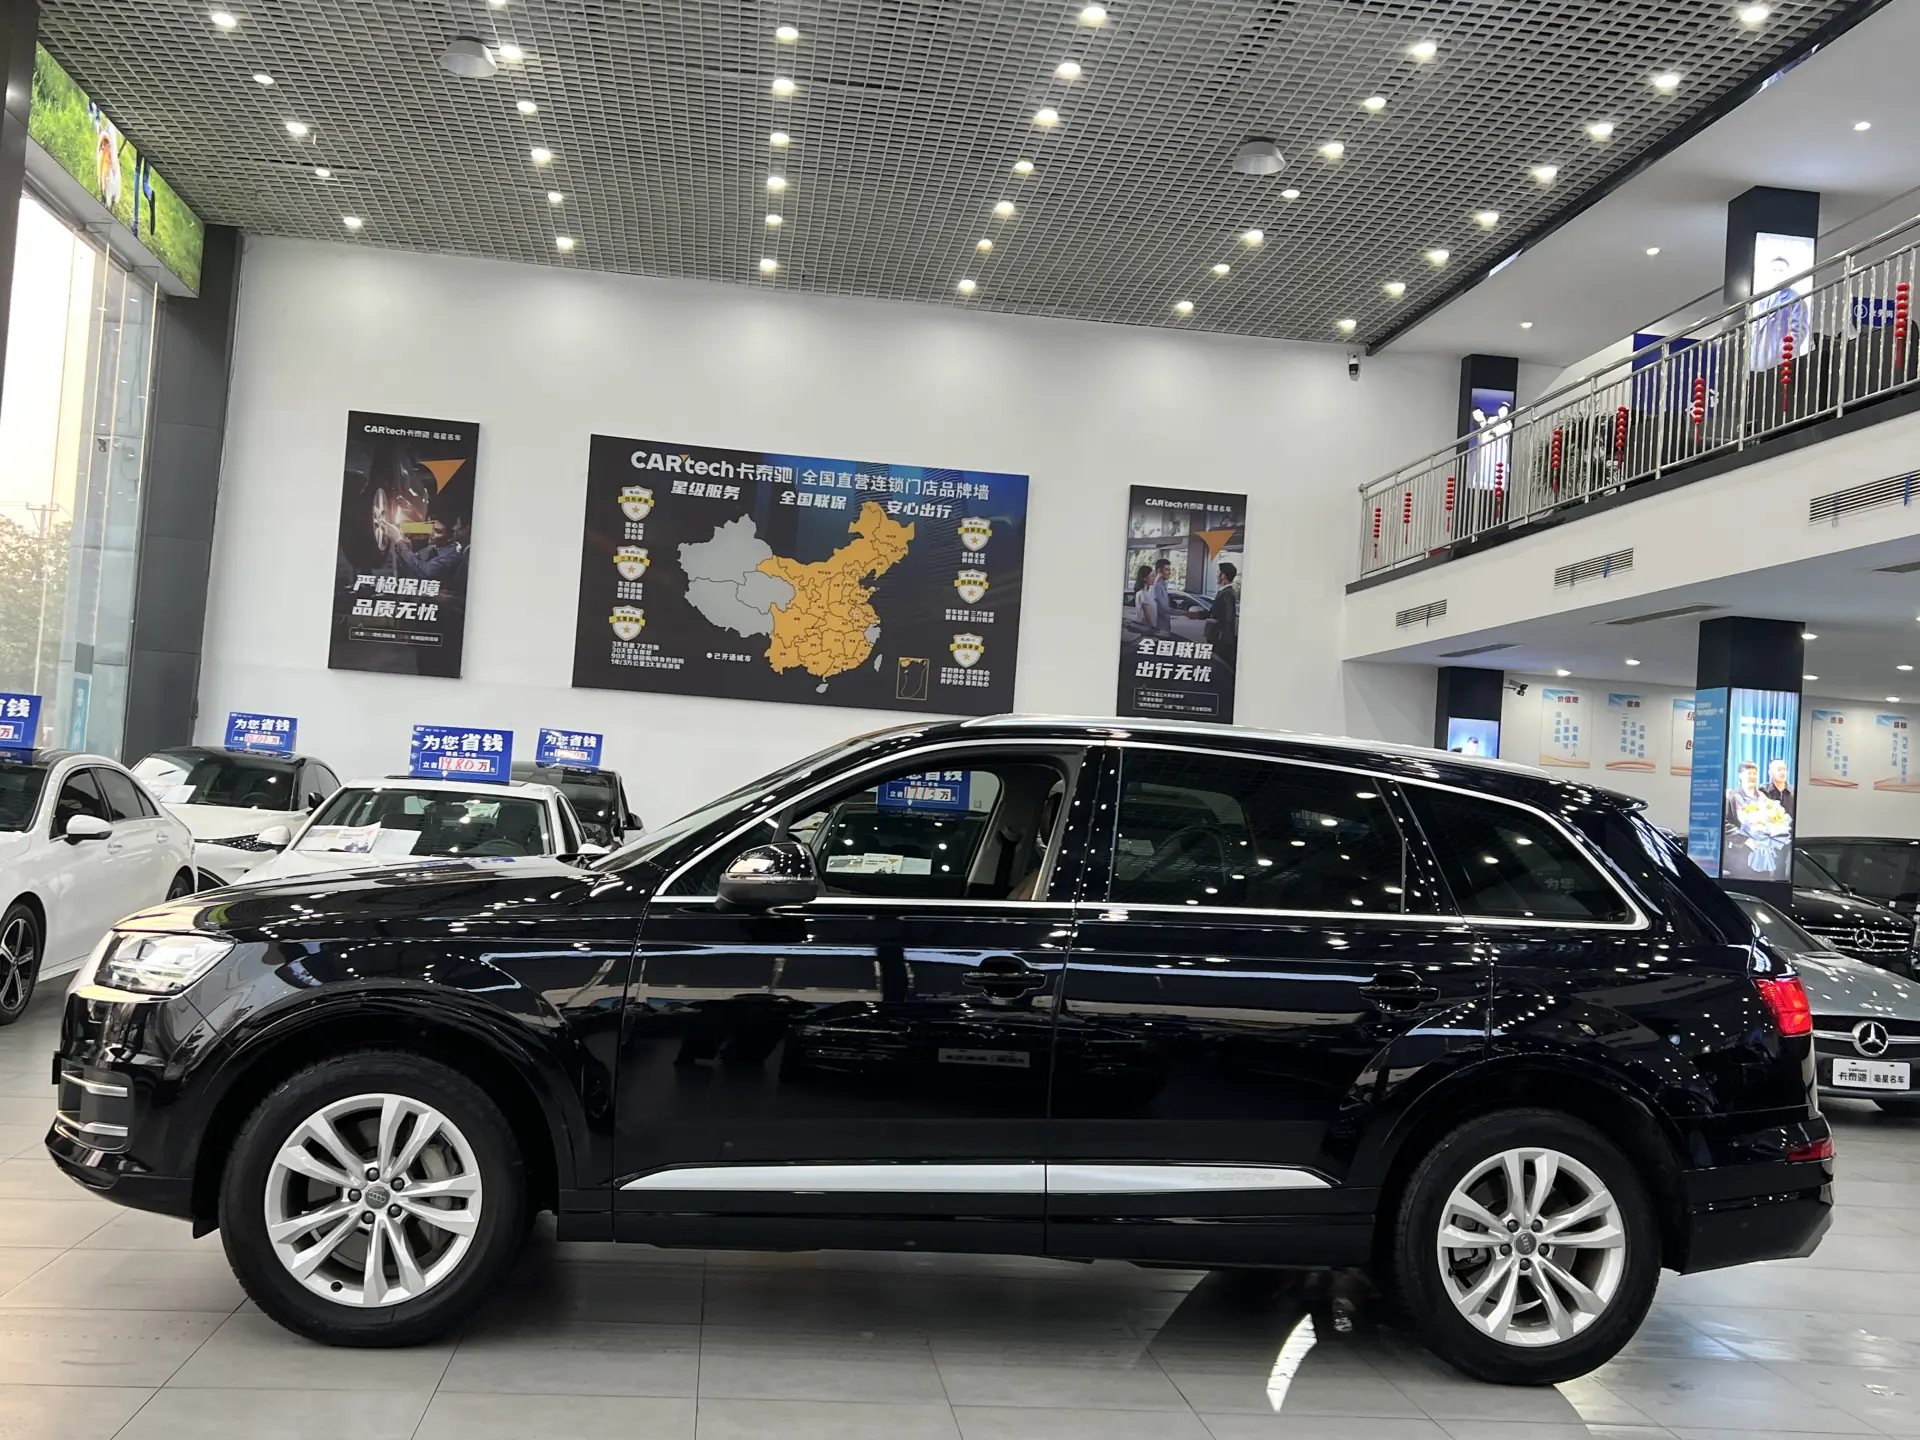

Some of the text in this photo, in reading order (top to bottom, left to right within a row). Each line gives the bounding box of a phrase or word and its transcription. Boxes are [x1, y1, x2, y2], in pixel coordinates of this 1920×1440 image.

[364, 424, 406, 436] CARtech
[631, 451, 990, 501] CARtech 卡泰驰 全国直营连锁门店品牌墙
[671, 480, 952, 519] 星级服务 全国联保 安心出行
[1145, 498, 1182, 509] CARtech
[352, 574, 441, 597] 严检保障
[351, 598, 439, 621] 品质无忧
[1136, 638, 1213, 660] 全国联保
[1135, 661, 1212, 682] 出行无忧
[0, 698, 30, 717] 钱
[234, 718, 290, 732] 为您省钱
[421, 733, 504, 752] 为您省钱
[544, 734, 597, 748] 为您省钱
